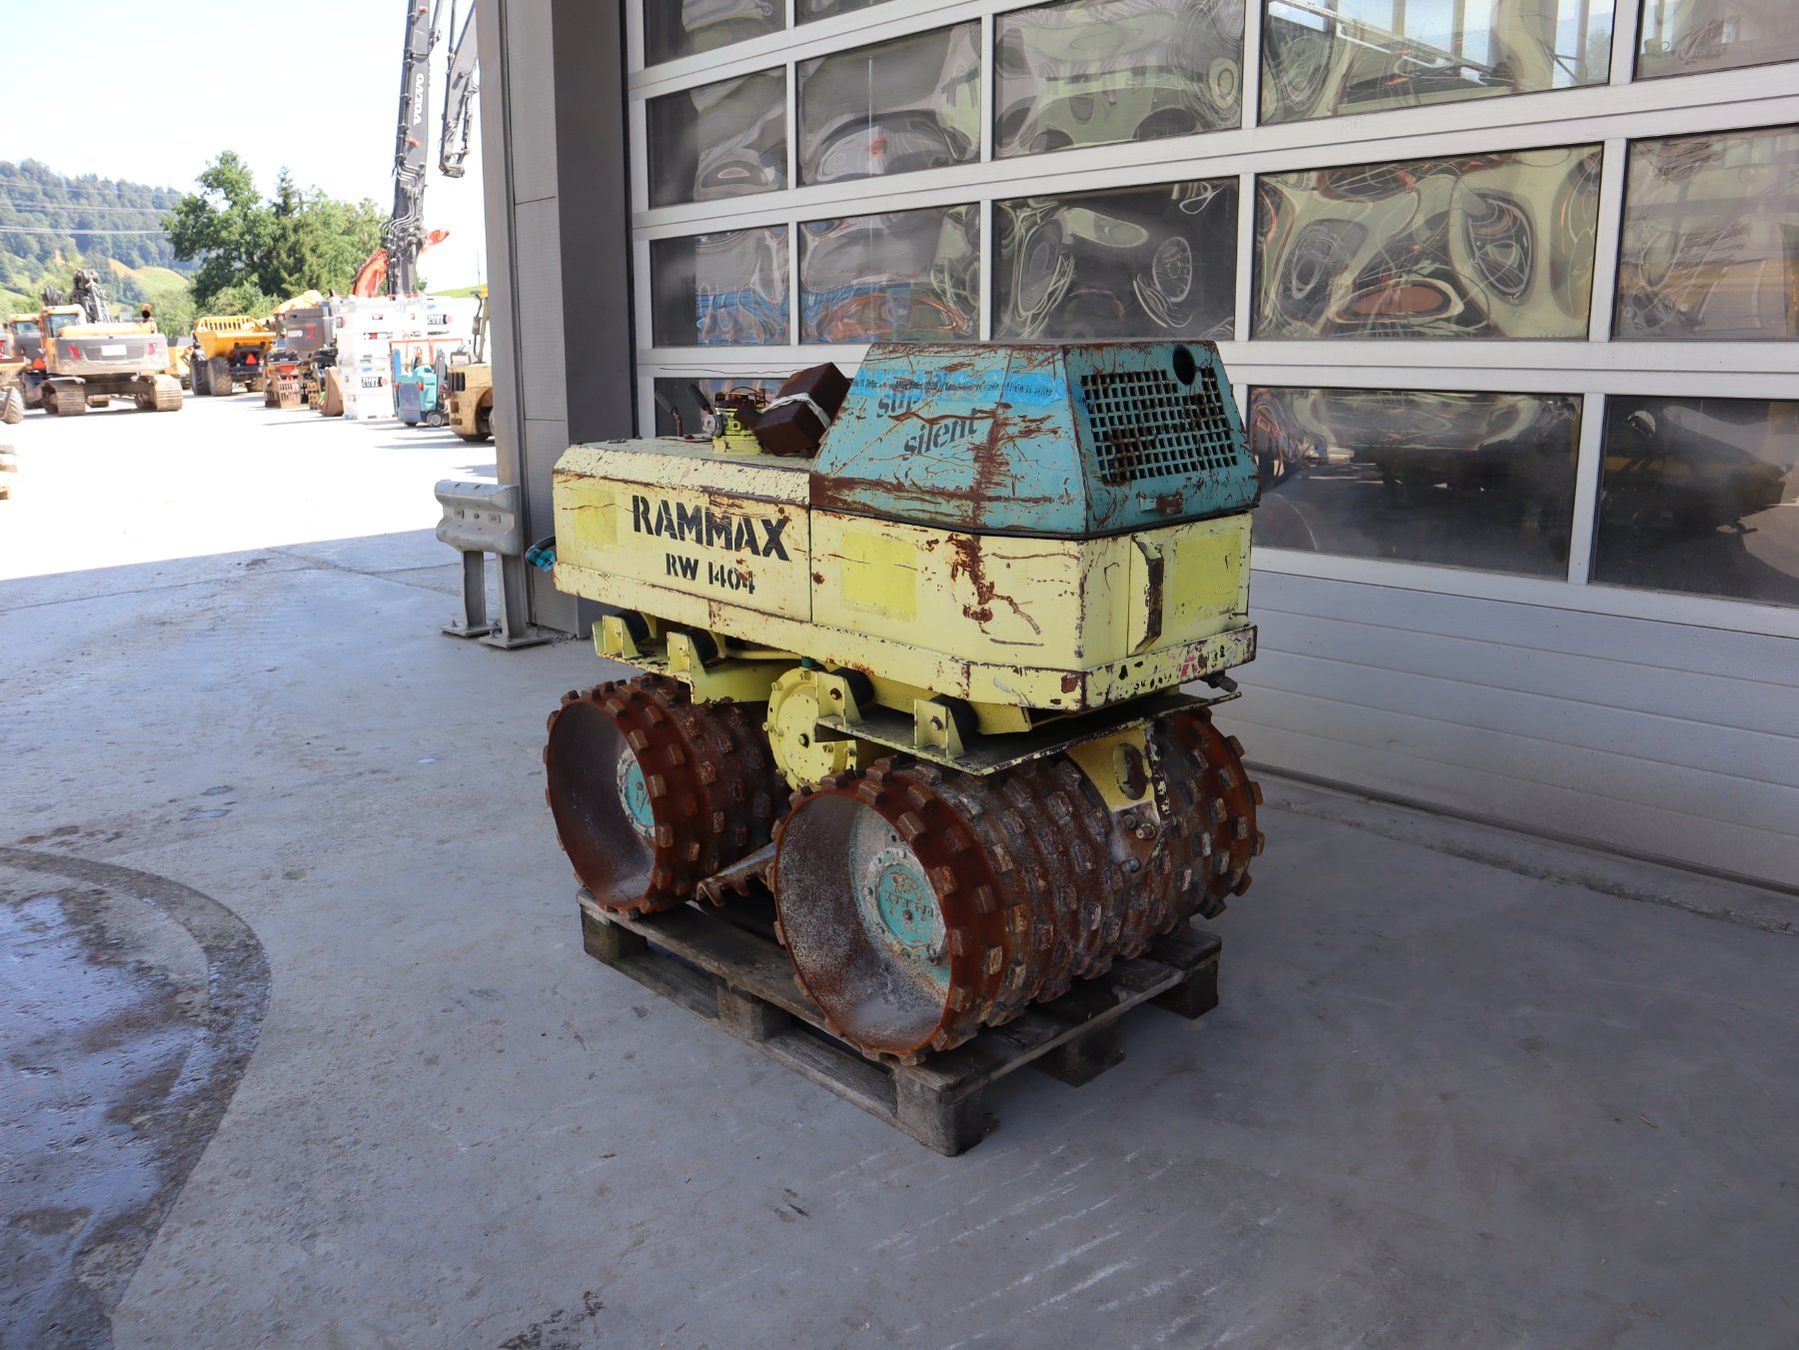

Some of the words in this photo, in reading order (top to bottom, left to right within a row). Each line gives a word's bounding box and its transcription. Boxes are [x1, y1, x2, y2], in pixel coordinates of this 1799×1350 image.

[413, 73, 425, 126] VOLVO
[902, 407, 978, 461] silent
[632, 494, 790, 562] RAMMAX
[665, 552, 699, 581] RW
[708, 561, 755, 594] 1404
